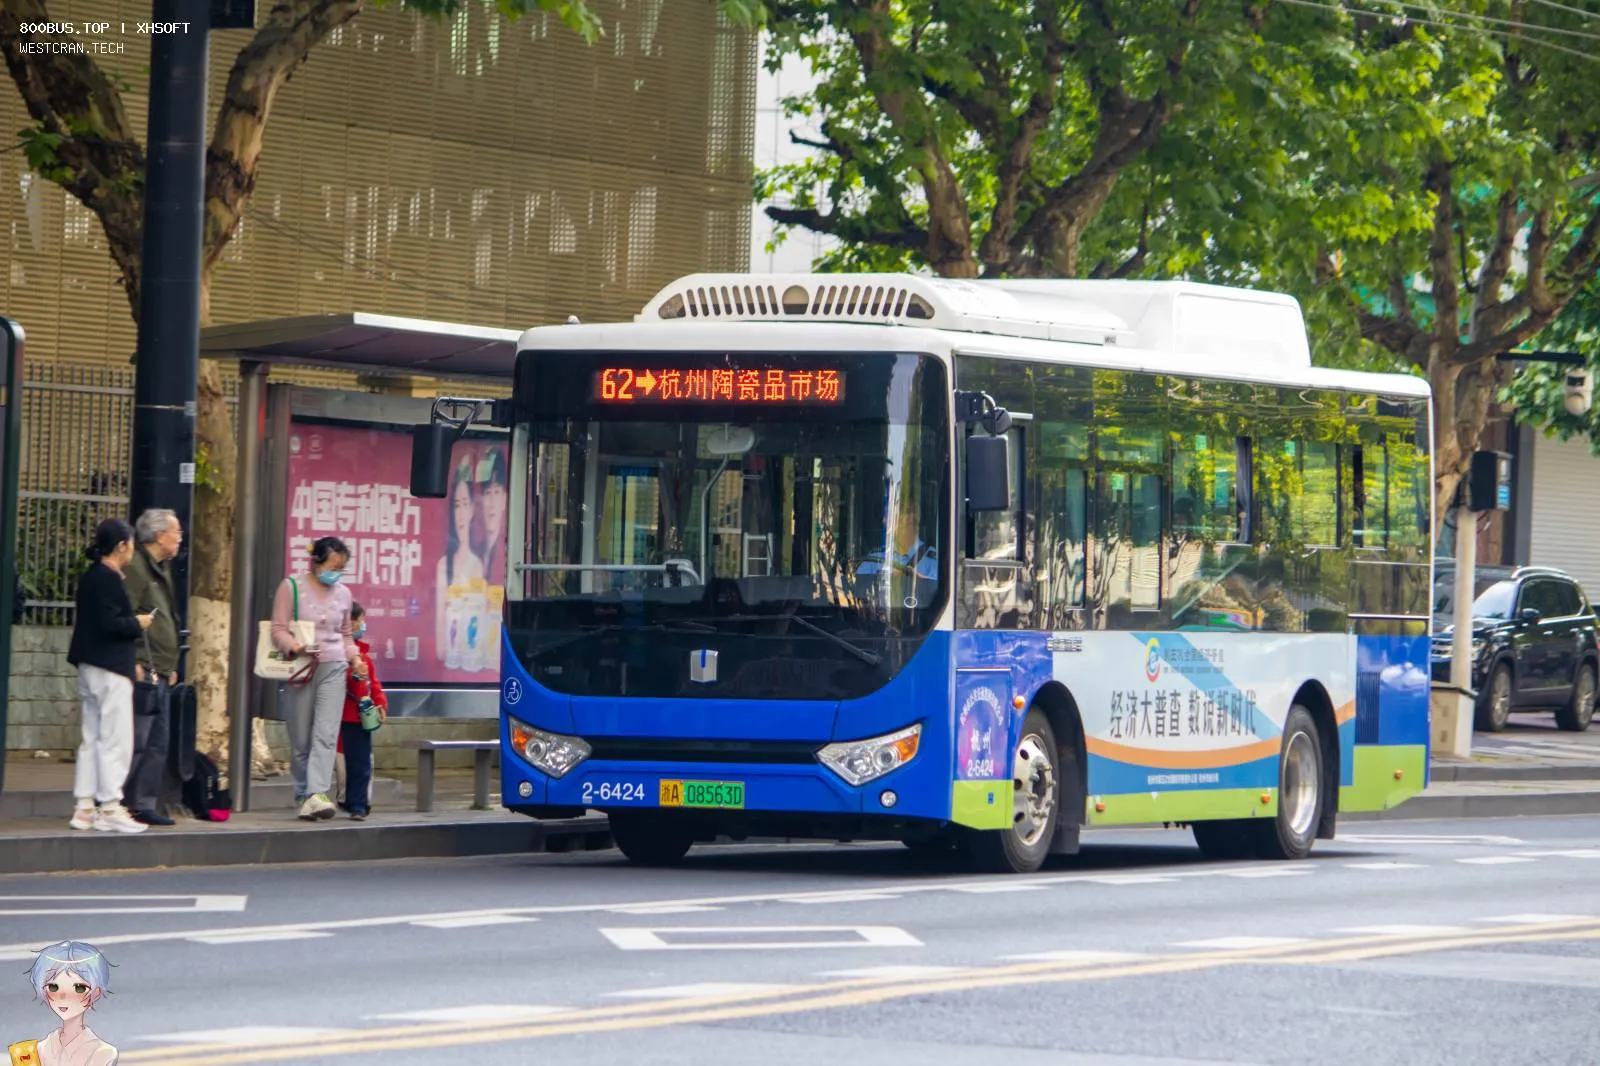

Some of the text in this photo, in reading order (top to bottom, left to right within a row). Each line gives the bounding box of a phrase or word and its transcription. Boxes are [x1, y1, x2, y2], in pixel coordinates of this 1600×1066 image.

[601, 368, 839, 400] 62 杭州陶瓷品市场
[291, 479, 421, 535] 中国专利配方
[1110, 689, 1181, 738] 经济大普查
[582, 782, 645, 800] 2-6424
